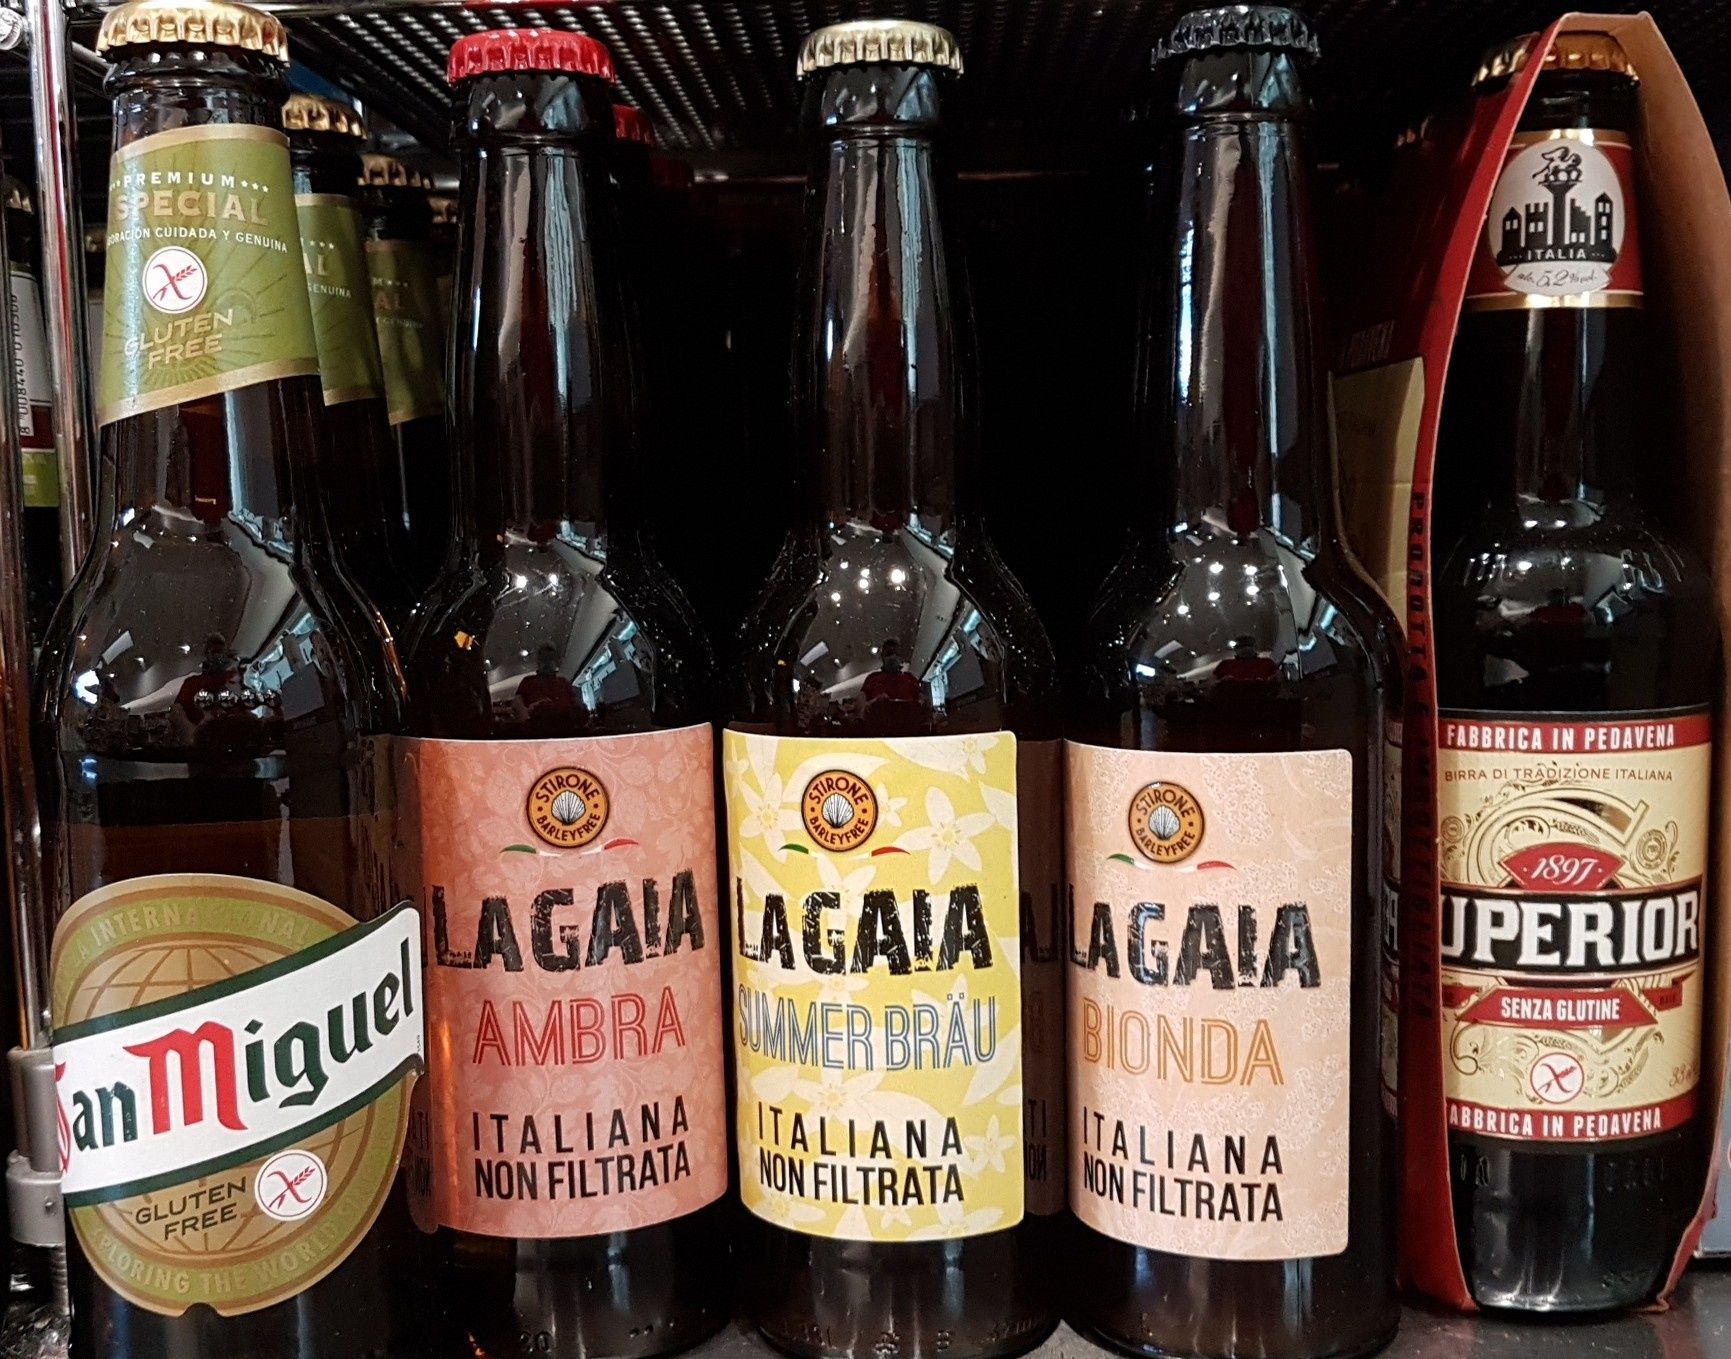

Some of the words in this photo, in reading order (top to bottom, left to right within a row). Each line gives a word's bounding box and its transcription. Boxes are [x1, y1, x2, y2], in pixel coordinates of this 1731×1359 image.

[124, 171, 235, 189] PREMIUM
[115, 189, 269, 226] SPECIAL
[155, 227, 217, 239] CUIDADA
[222, 230, 230, 240] Y
[235, 232, 288, 253] GENUINA
[1527, 249, 1587, 260] ITALIA
[123, 309, 234, 357] GLUTEN
[148, 333, 223, 370] FREE
[1447, 723, 1542, 750] FABBRICA
[1553, 727, 1575, 751] IN
[1584, 723, 1675, 750] PEDAVENA
[535, 773, 600, 802] STIRONE
[808, 776, 869, 806] STIRONE
[1445, 769, 1487, 782] BIRRA
[1493, 769, 1507, 779] DI
[1513, 768, 1611, 780] TRADIZIONE
[1615, 768, 1673, 782] ITALIANA
[1135, 788, 1196, 819] STIRONE
[536, 812, 601, 842] BARLEYFREE
[809, 816, 870, 846] BARLEYFREE
[1136, 826, 1196, 857] BARLEYFREE
[1531, 854, 1599, 886] 1897
[472, 985, 686, 1067] AMBRA
[1501, 996, 1553, 1021] SENZA
[1556, 998, 1621, 1021] GLUTINE
[122, 937, 415, 1135] Miguel
[738, 983, 874, 1071] SUMMER
[885, 992, 996, 1072] BRÄU
[1082, 996, 1285, 1086] BIONDA
[472, 1095, 689, 1154] ITALIANA
[758, 1101, 963, 1159] ITALIANA
[1083, 1106, 1283, 1175] ITALIANA
[1543, 1116, 1563, 1138] IN
[1573, 1107, 1662, 1137] PEDAVENA
[474, 1158, 538, 1200] NON
[548, 1140, 691, 1200] FILTRATA
[760, 1147, 805, 1198] NON
[814, 1163, 965, 1206] FILTRATA
[1083, 1151, 1125, 1204] NON
[1133, 1170, 1283, 1222] FILTRATA
[136, 1176, 246, 1226] GLUTEN
[164, 1203, 237, 1241] FREE
[200, 1272, 248, 1294] THE
[256, 1224, 339, 1281] WORLD
